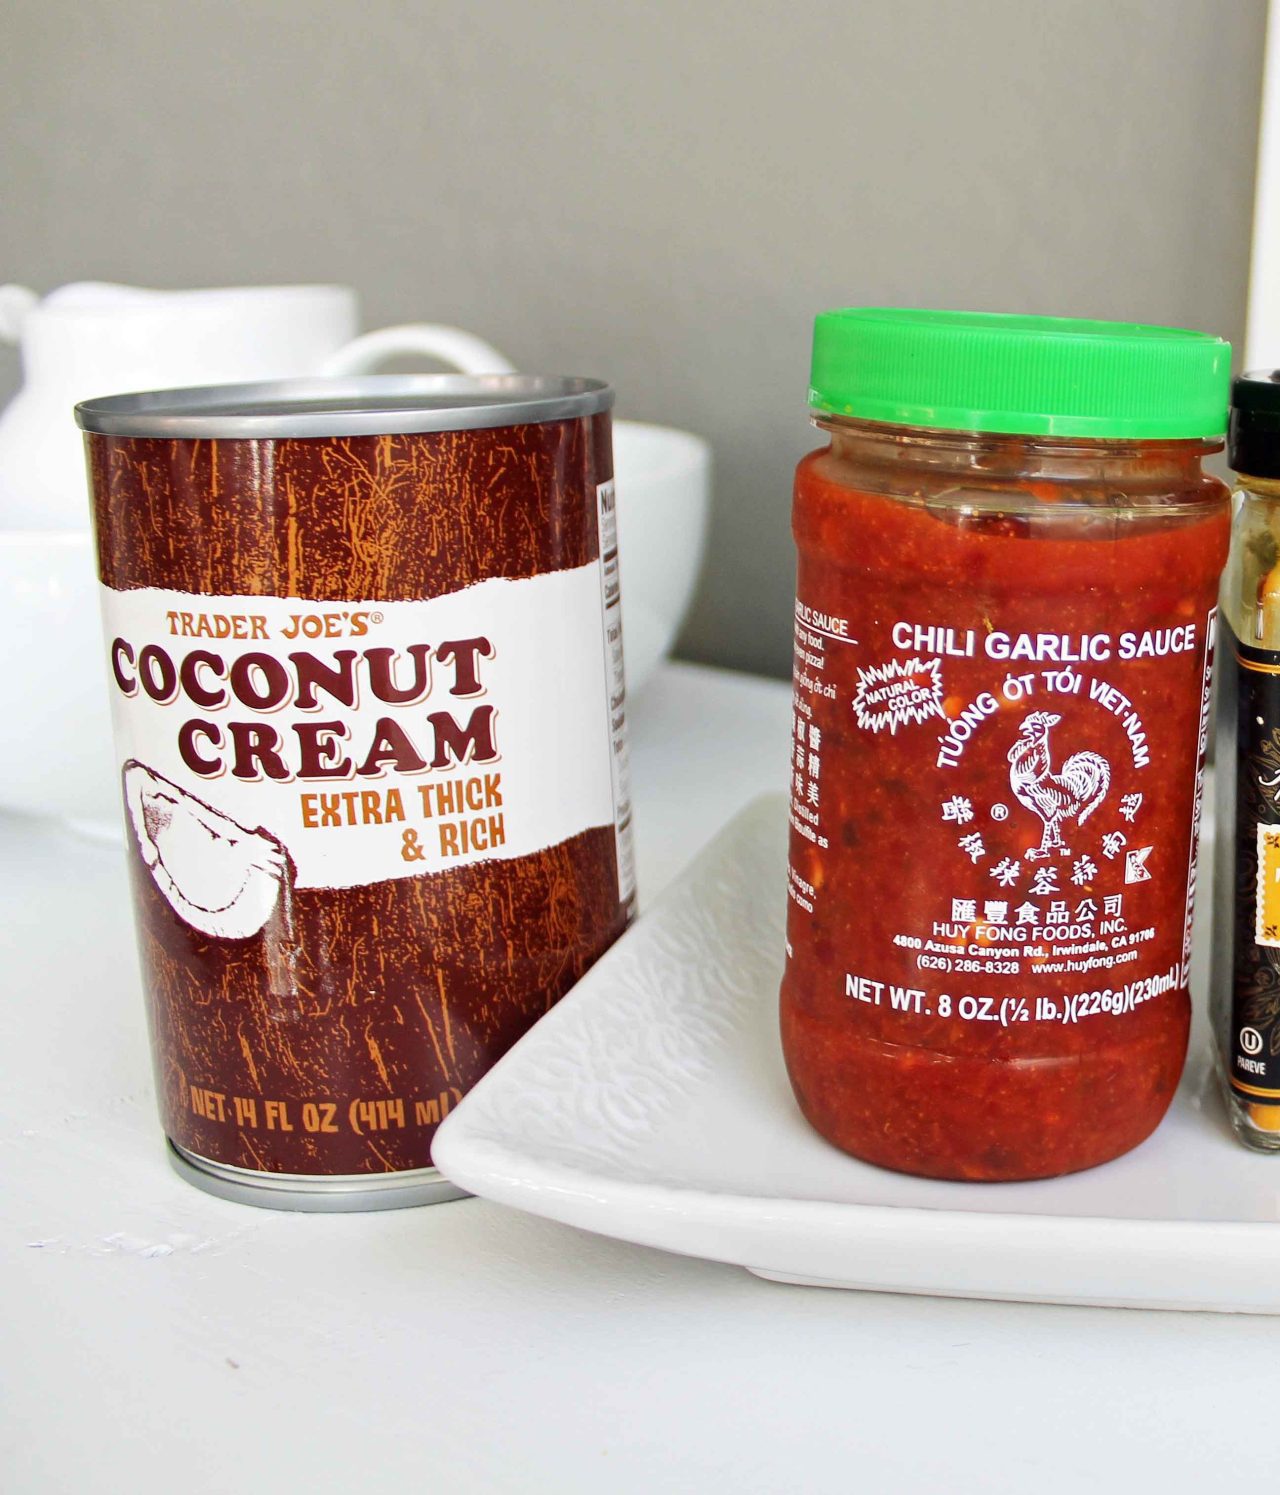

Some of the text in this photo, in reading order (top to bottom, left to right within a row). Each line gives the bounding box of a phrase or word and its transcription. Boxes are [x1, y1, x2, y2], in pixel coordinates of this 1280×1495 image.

[166, 611, 269, 641] TRADER
[812, 610, 848, 636] SAUCE
[892, 621, 1196, 661] CHILI GARLIC SAUCE
[111, 636, 496, 710] COCONUT
[866, 679, 919, 705] NATURAL
[888, 688, 932, 711] COLOR
[178, 705, 503, 783] CREAM
[302, 773, 503, 829] EXTRA THICK
[401, 812, 506, 863] & RICH
[817, 834, 829, 849] as
[951, 894, 1123, 925] 匯豐食品公司
[893, 928, 1155, 960] 4800 Azusa Canyon Rd., Irwindale, CA 91706
[933, 918, 1128, 942] HUY FONG FOODS, INC.
[916, 949, 1138, 975] (626) 286-8328 www.huyfong.com
[845, 974, 883, 1003] NET
[889, 988, 931, 1015] WT.
[938, 995, 951, 1018] 8
[1237, 1055, 1266, 1076] PAREVE
[190, 1085, 226, 1122] NET
[233, 1097, 257, 1129] 14
[264, 1101, 293, 1131] FL
[302, 1103, 339, 1133] OZ
[349, 1098, 405, 1136] (414
